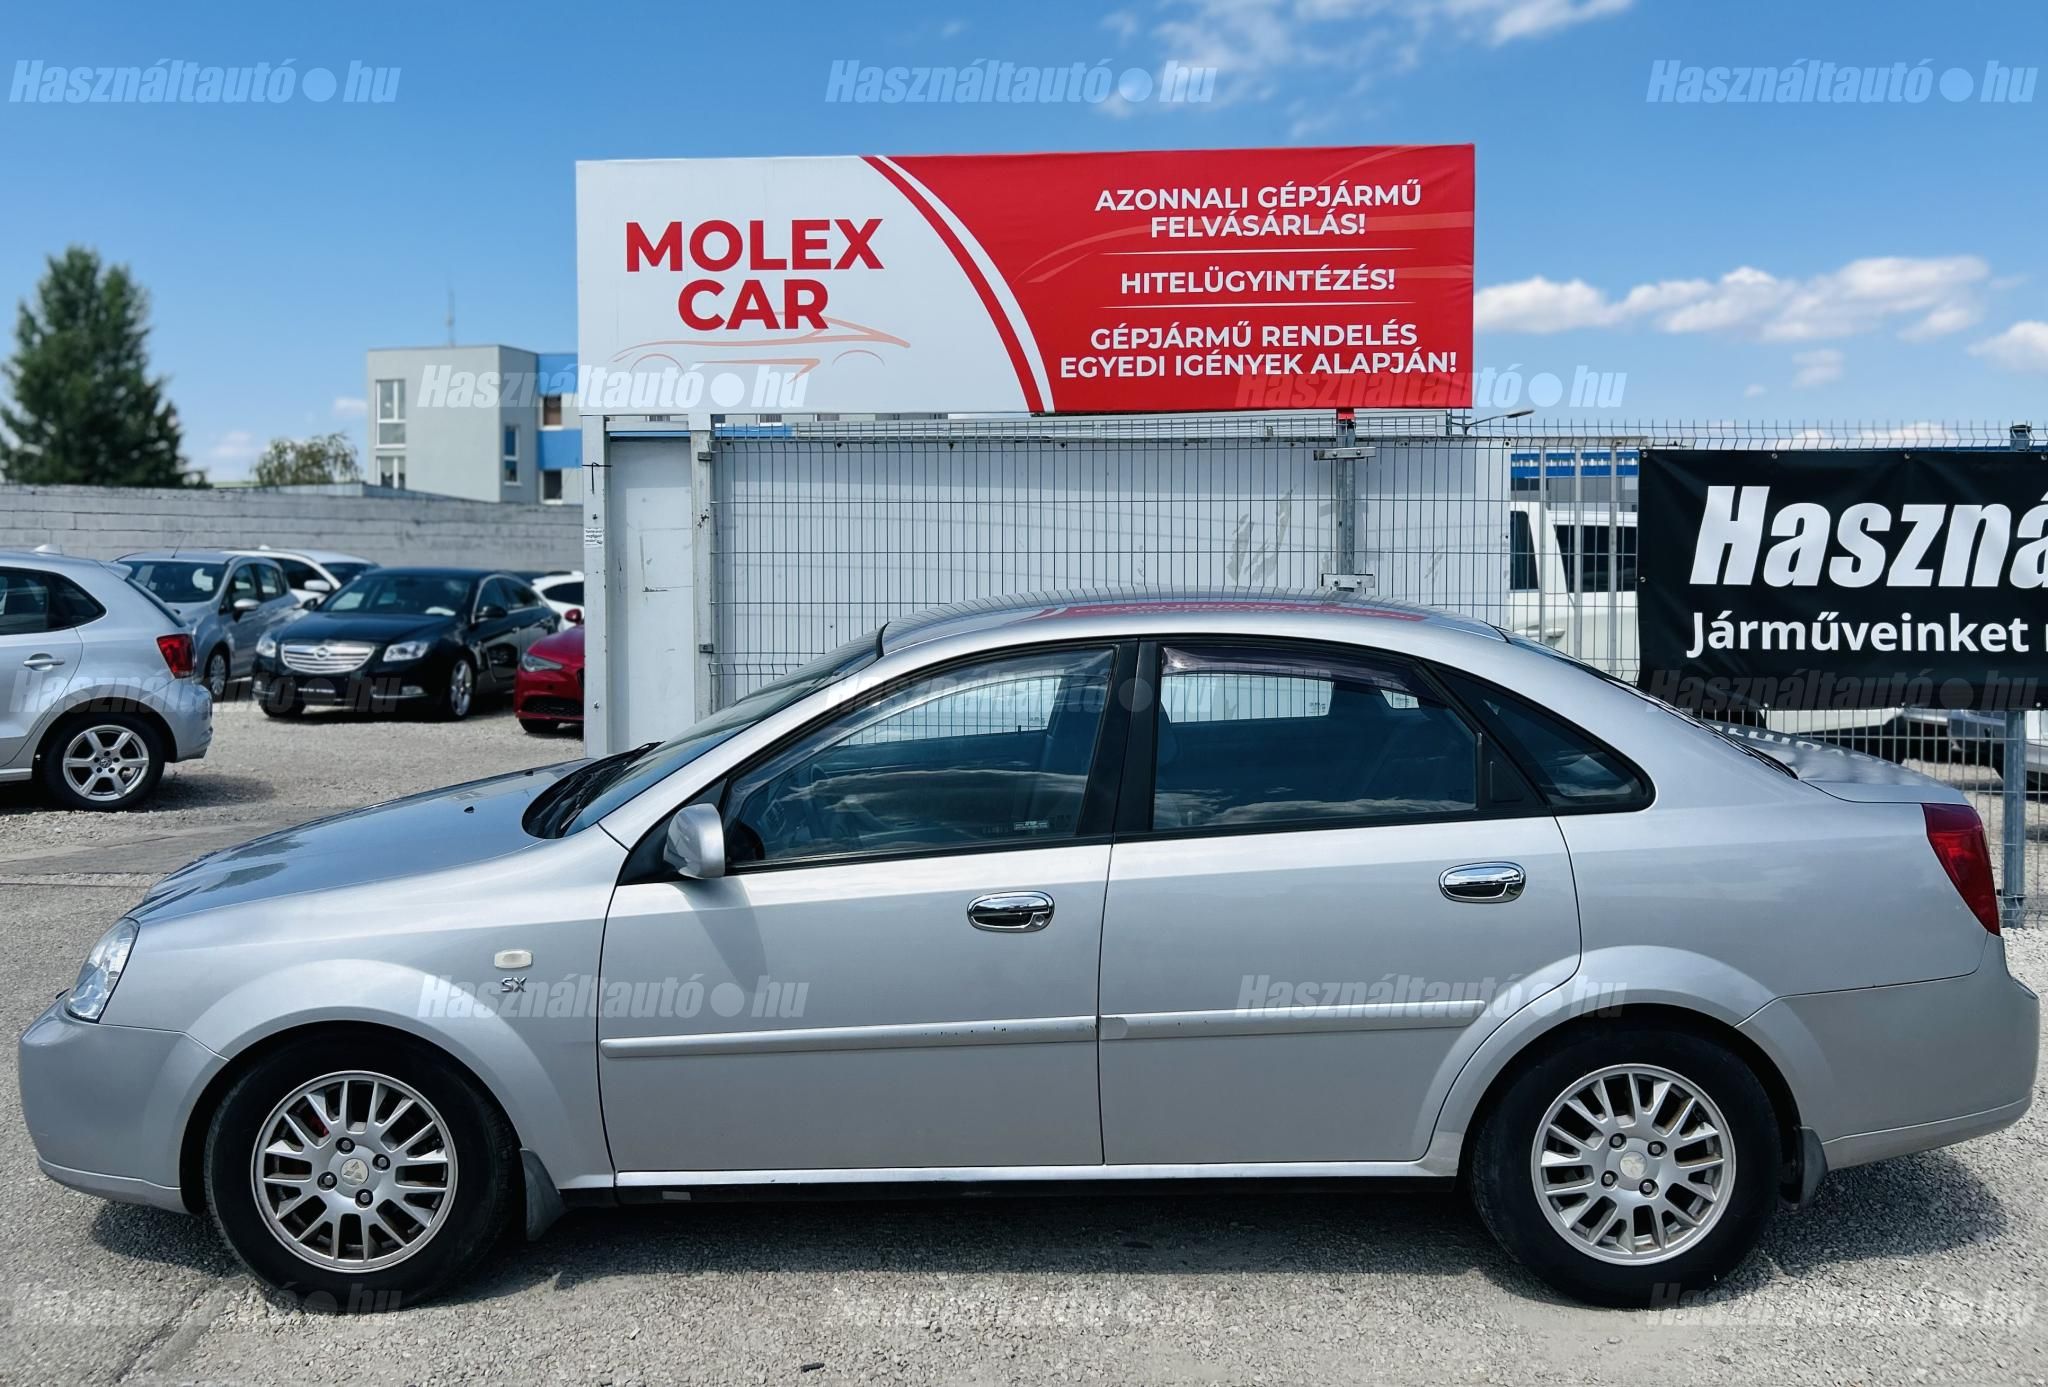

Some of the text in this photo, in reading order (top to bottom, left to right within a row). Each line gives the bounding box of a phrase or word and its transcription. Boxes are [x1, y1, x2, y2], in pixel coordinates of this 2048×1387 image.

[1095, 179, 1422, 211] AZONNALI GÉPJÁRMŰ
[1151, 208, 1366, 238] FELVÁSÁRLÁS!
[625, 218, 885, 273] MOLEX
[1121, 264, 1395, 294] HITELÜGYINTÉZÉS!
[677, 278, 829, 331] CAR
[1090, 318, 1418, 350] GÉPJÁRMŰ RENDELÉS
[1060, 347, 1457, 379] EGYEDI IGÉNYEK ALAPJÁN!
[1686, 610, 2030, 658] Járműveinket
[500, 976, 528, 993] SX
